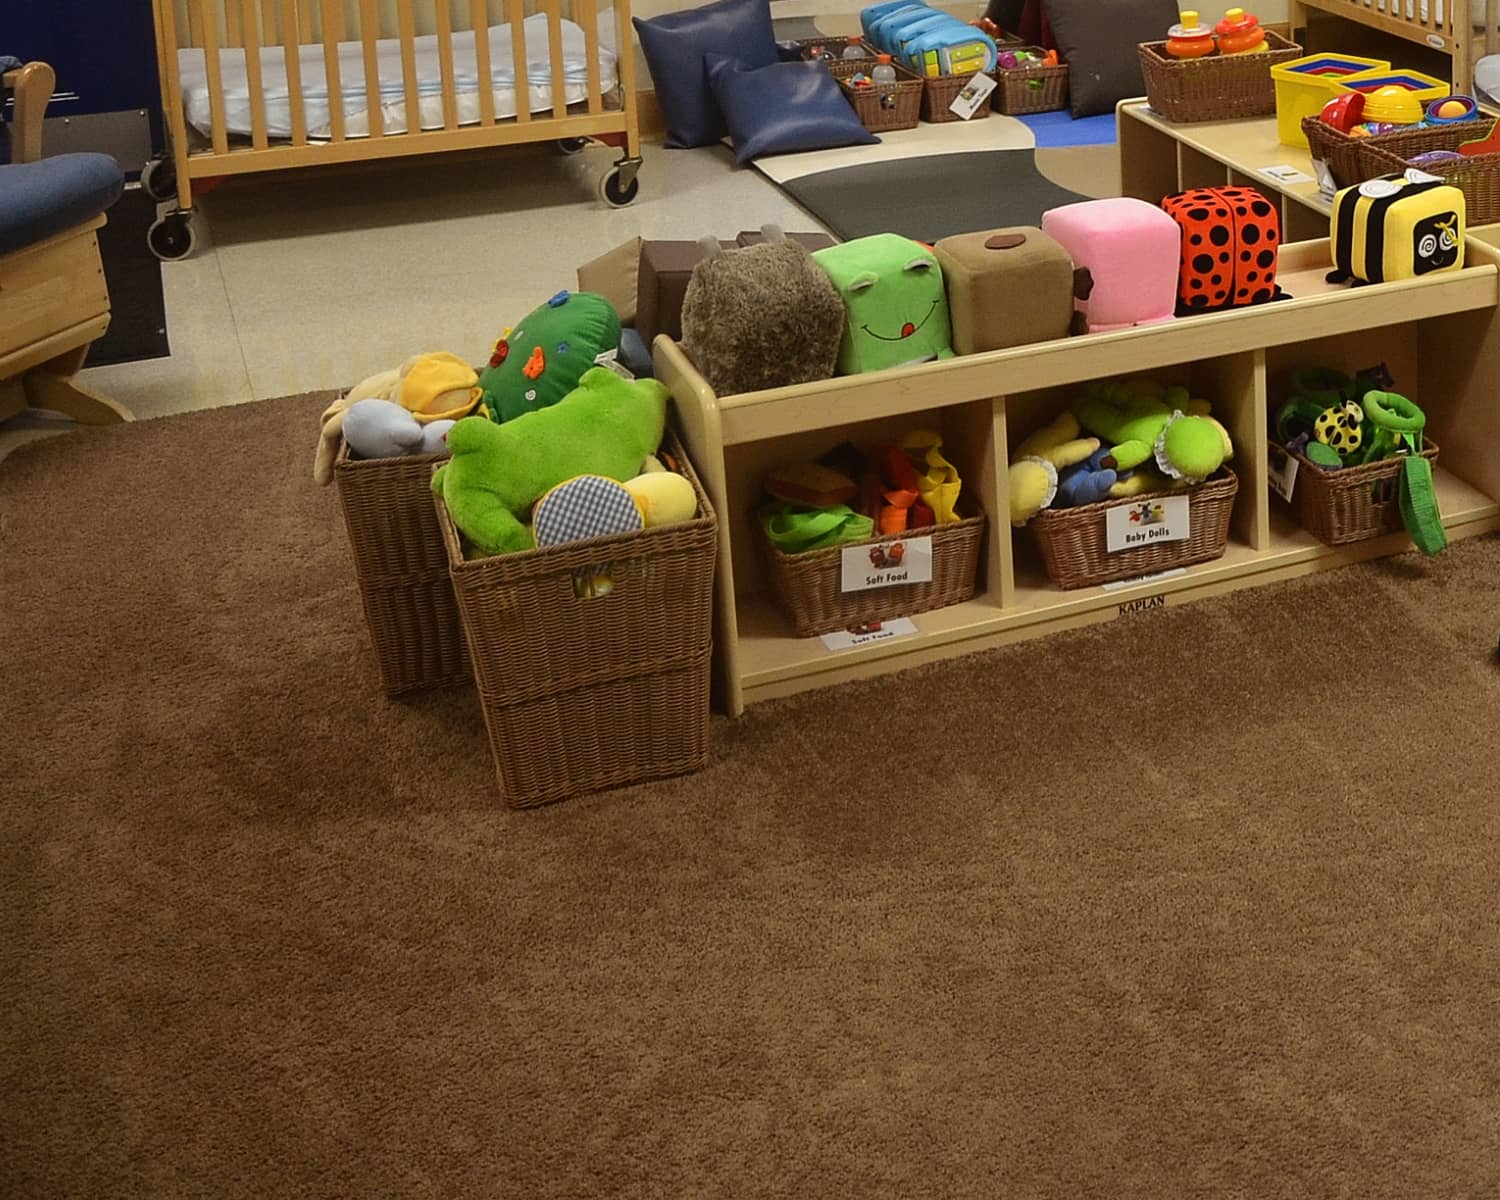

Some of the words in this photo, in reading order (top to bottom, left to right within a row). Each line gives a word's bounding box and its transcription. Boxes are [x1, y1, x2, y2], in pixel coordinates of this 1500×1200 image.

[1126, 532, 1146, 543] Baby
[1148, 528, 1170, 538] Dolls
[866, 574, 884, 585] Soft
[886, 571, 908, 582] Food
[1119, 596, 1165, 615] KAPLAN
